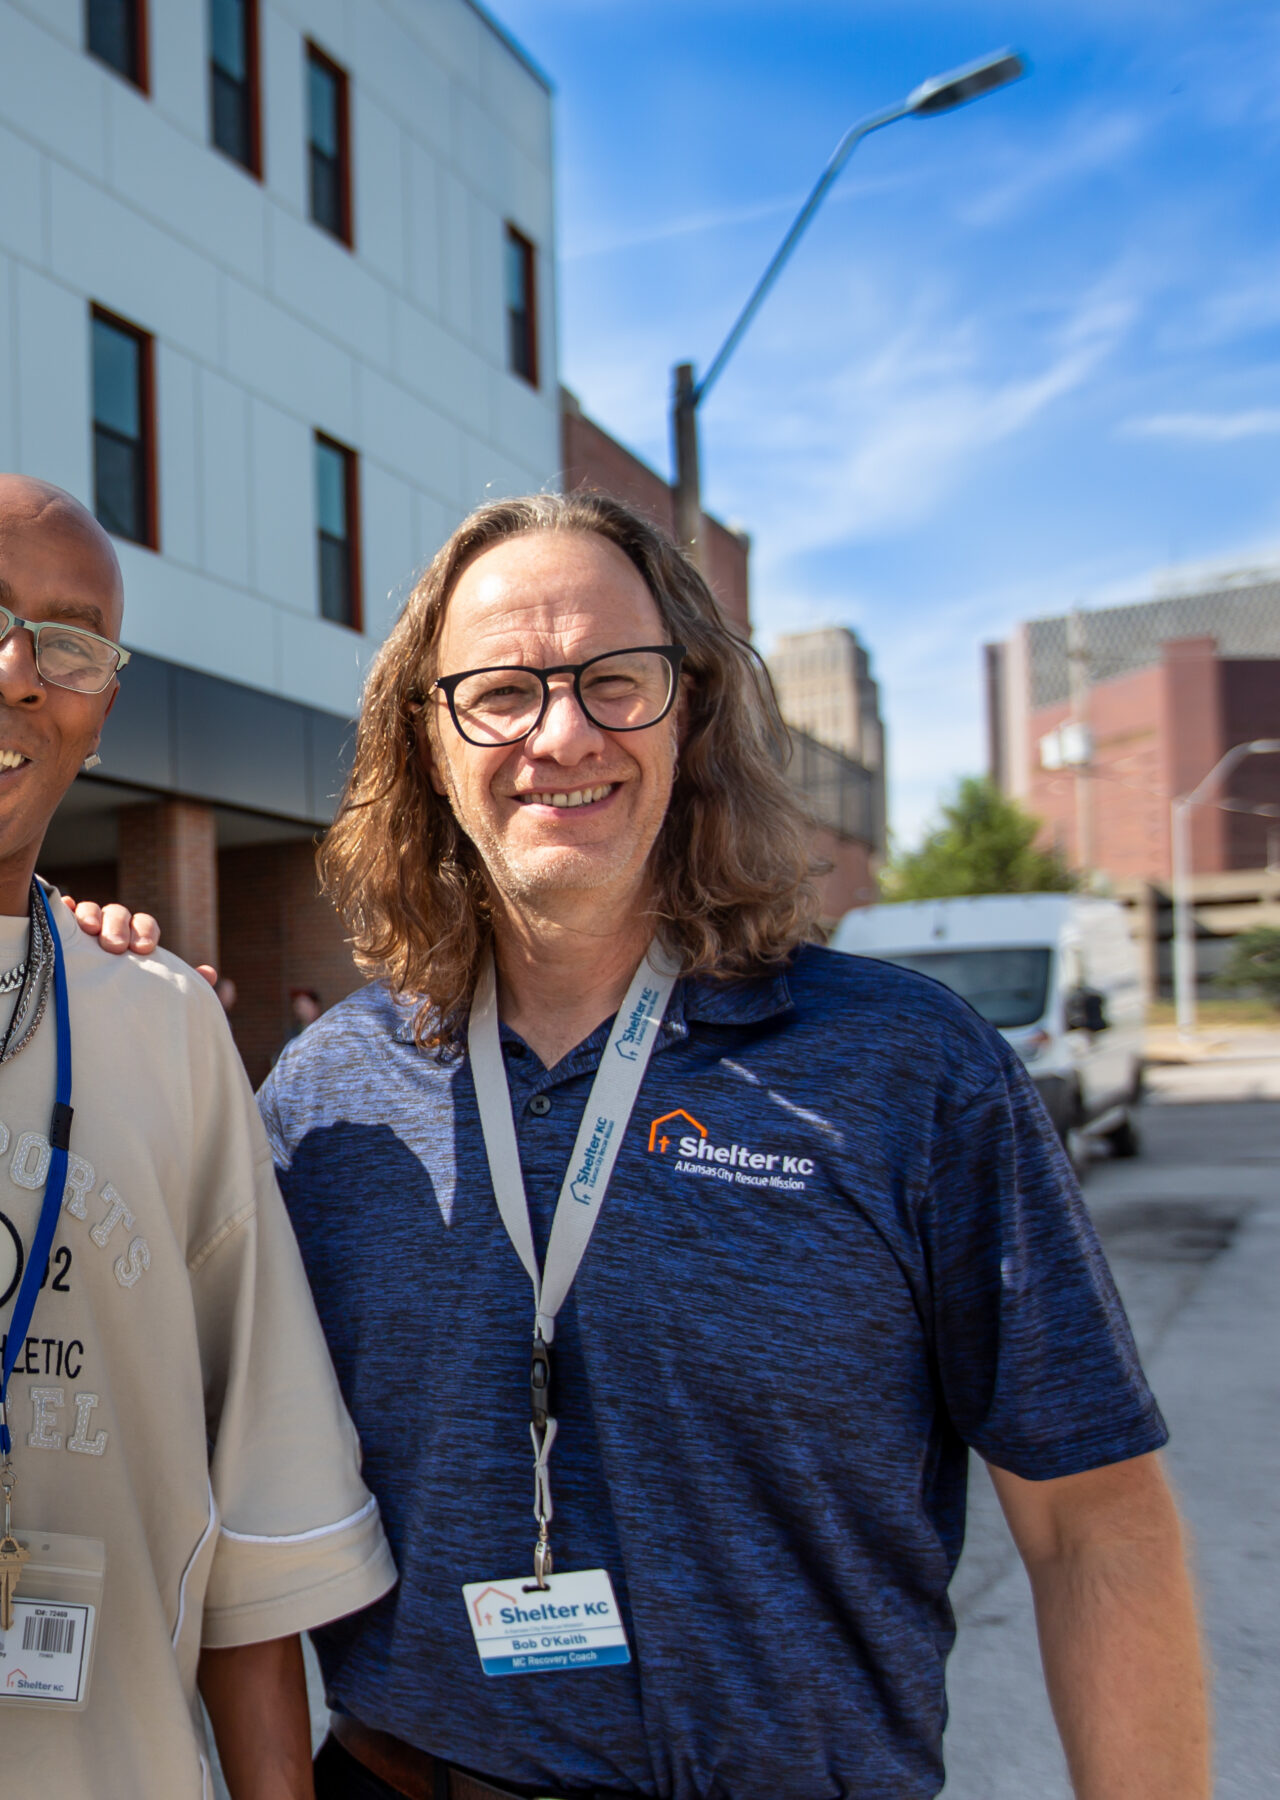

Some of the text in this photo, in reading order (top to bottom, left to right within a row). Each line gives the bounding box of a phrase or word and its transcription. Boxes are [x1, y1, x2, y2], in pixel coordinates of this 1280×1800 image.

[622, 1000, 647, 1043] Shelter
[577, 1116, 607, 1185] Shelter KC
[678, 1136, 814, 1175] Shelter KC
[683, 1161, 716, 1176] Kansas
[716, 1167, 734, 1182] City
[735, 1171, 768, 1186] Rescue
[769, 1175, 805, 1190] Mission
[499, 1601, 609, 1625] Shelter KC
[511, 1633, 587, 1651] Bob O'Keith
[527, 1653, 567, 1667] Recovery
[569, 1650, 597, 1662] Coach
[17, 1679, 52, 1691] Shelter
[53, 1684, 65, 1692] KC
